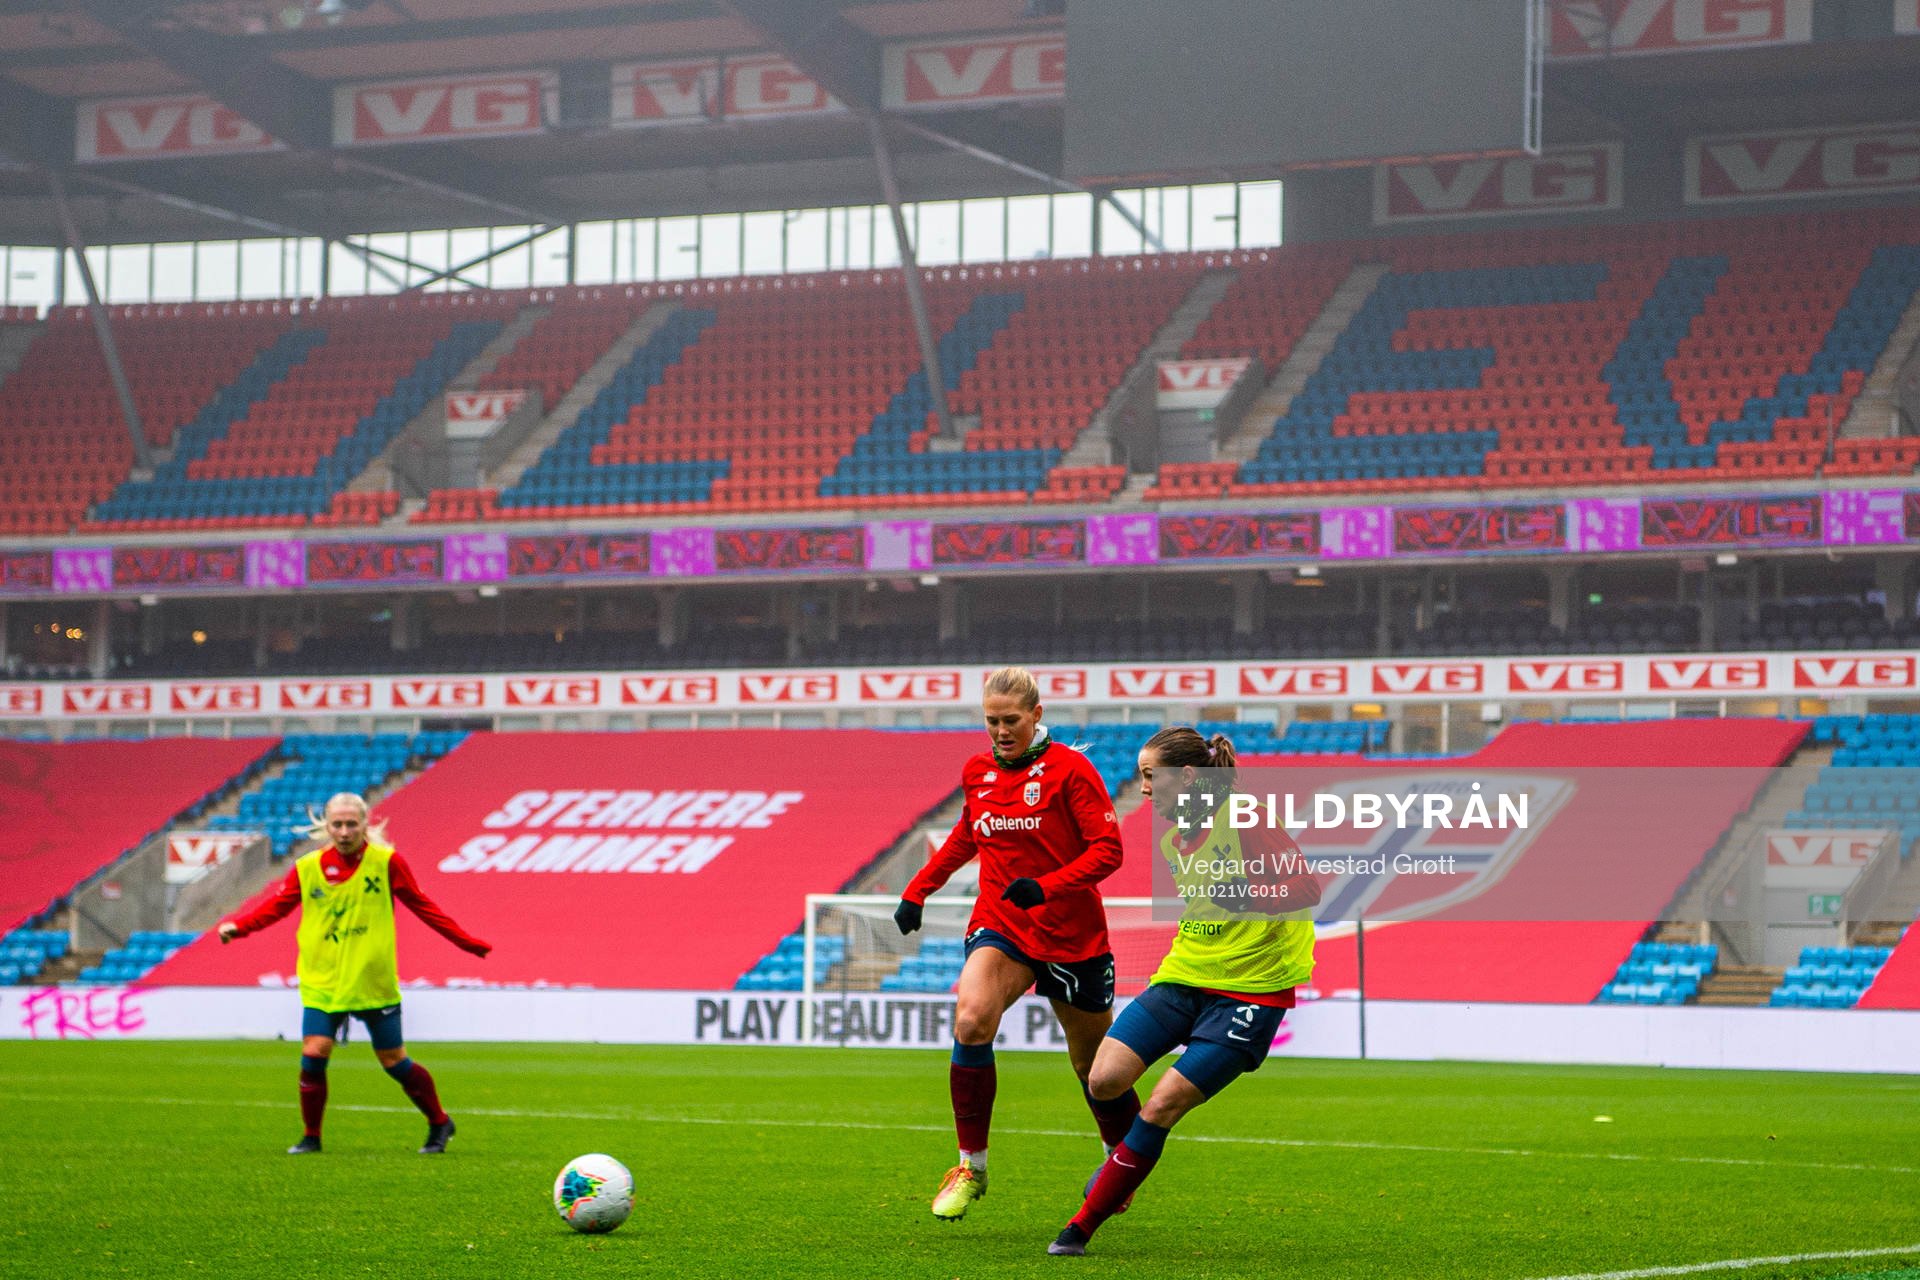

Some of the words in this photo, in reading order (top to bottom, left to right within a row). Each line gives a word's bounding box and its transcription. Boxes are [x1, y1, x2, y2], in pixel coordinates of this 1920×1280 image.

[1556, 0, 1773, 49] VG
[640, 65, 816, 112] VG
[357, 83, 529, 134] VG
[107, 106, 263, 148] VG
[1704, 137, 1920, 192] VG
[1396, 158, 1578, 209] VG
[1114, 670, 1208, 695] VG
[1244, 668, 1340, 692] VG
[1376, 667, 1477, 691] VG
[1514, 664, 1616, 689] VG
[1654, 662, 1759, 687] VG
[1800, 659, 1907, 686] VG
[66, 687, 145, 709] VG
[174, 686, 254, 708] VG
[284, 684, 365, 706] VG
[395, 681, 479, 705] VG
[509, 679, 594, 704] VG
[624, 677, 711, 702] VG
[743, 676, 832, 700] VG
[863, 674, 954, 699] VG
[483, 791, 803, 828] STERKERE
[989, 815, 1042, 831] telenor
[437, 834, 733, 873] SAMMEN
[21, 985, 160, 1040] FREE
[695, 999, 787, 1042] PLAY
